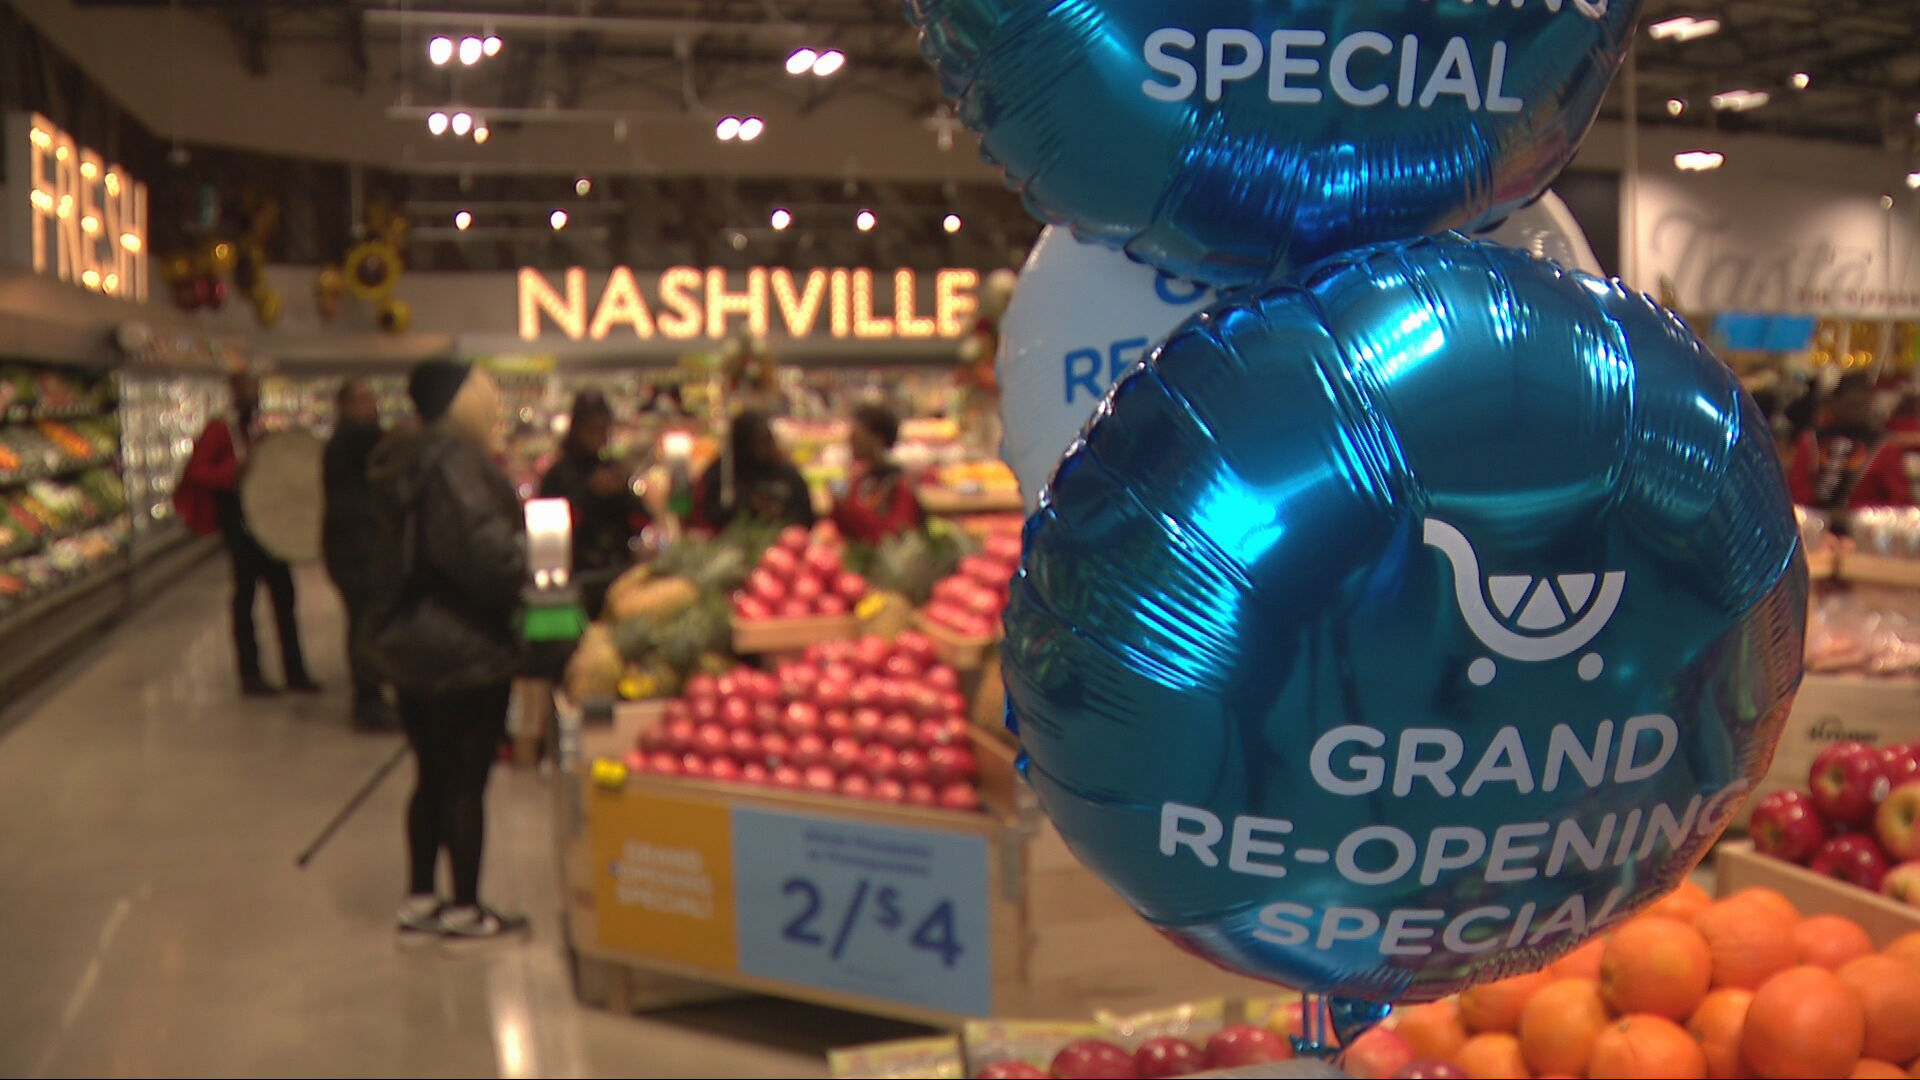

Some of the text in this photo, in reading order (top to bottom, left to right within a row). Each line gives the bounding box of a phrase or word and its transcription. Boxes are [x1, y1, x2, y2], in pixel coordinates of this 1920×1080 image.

[1141, 27, 1523, 113] SPECIAL
[30, 112, 149, 304] FRESH
[517, 265, 979, 341] NASHVILLE
[1310, 714, 1679, 798] GRAND
[1158, 777, 1749, 886] RE-OPENING
[1252, 885, 1629, 956] SPECIAL
